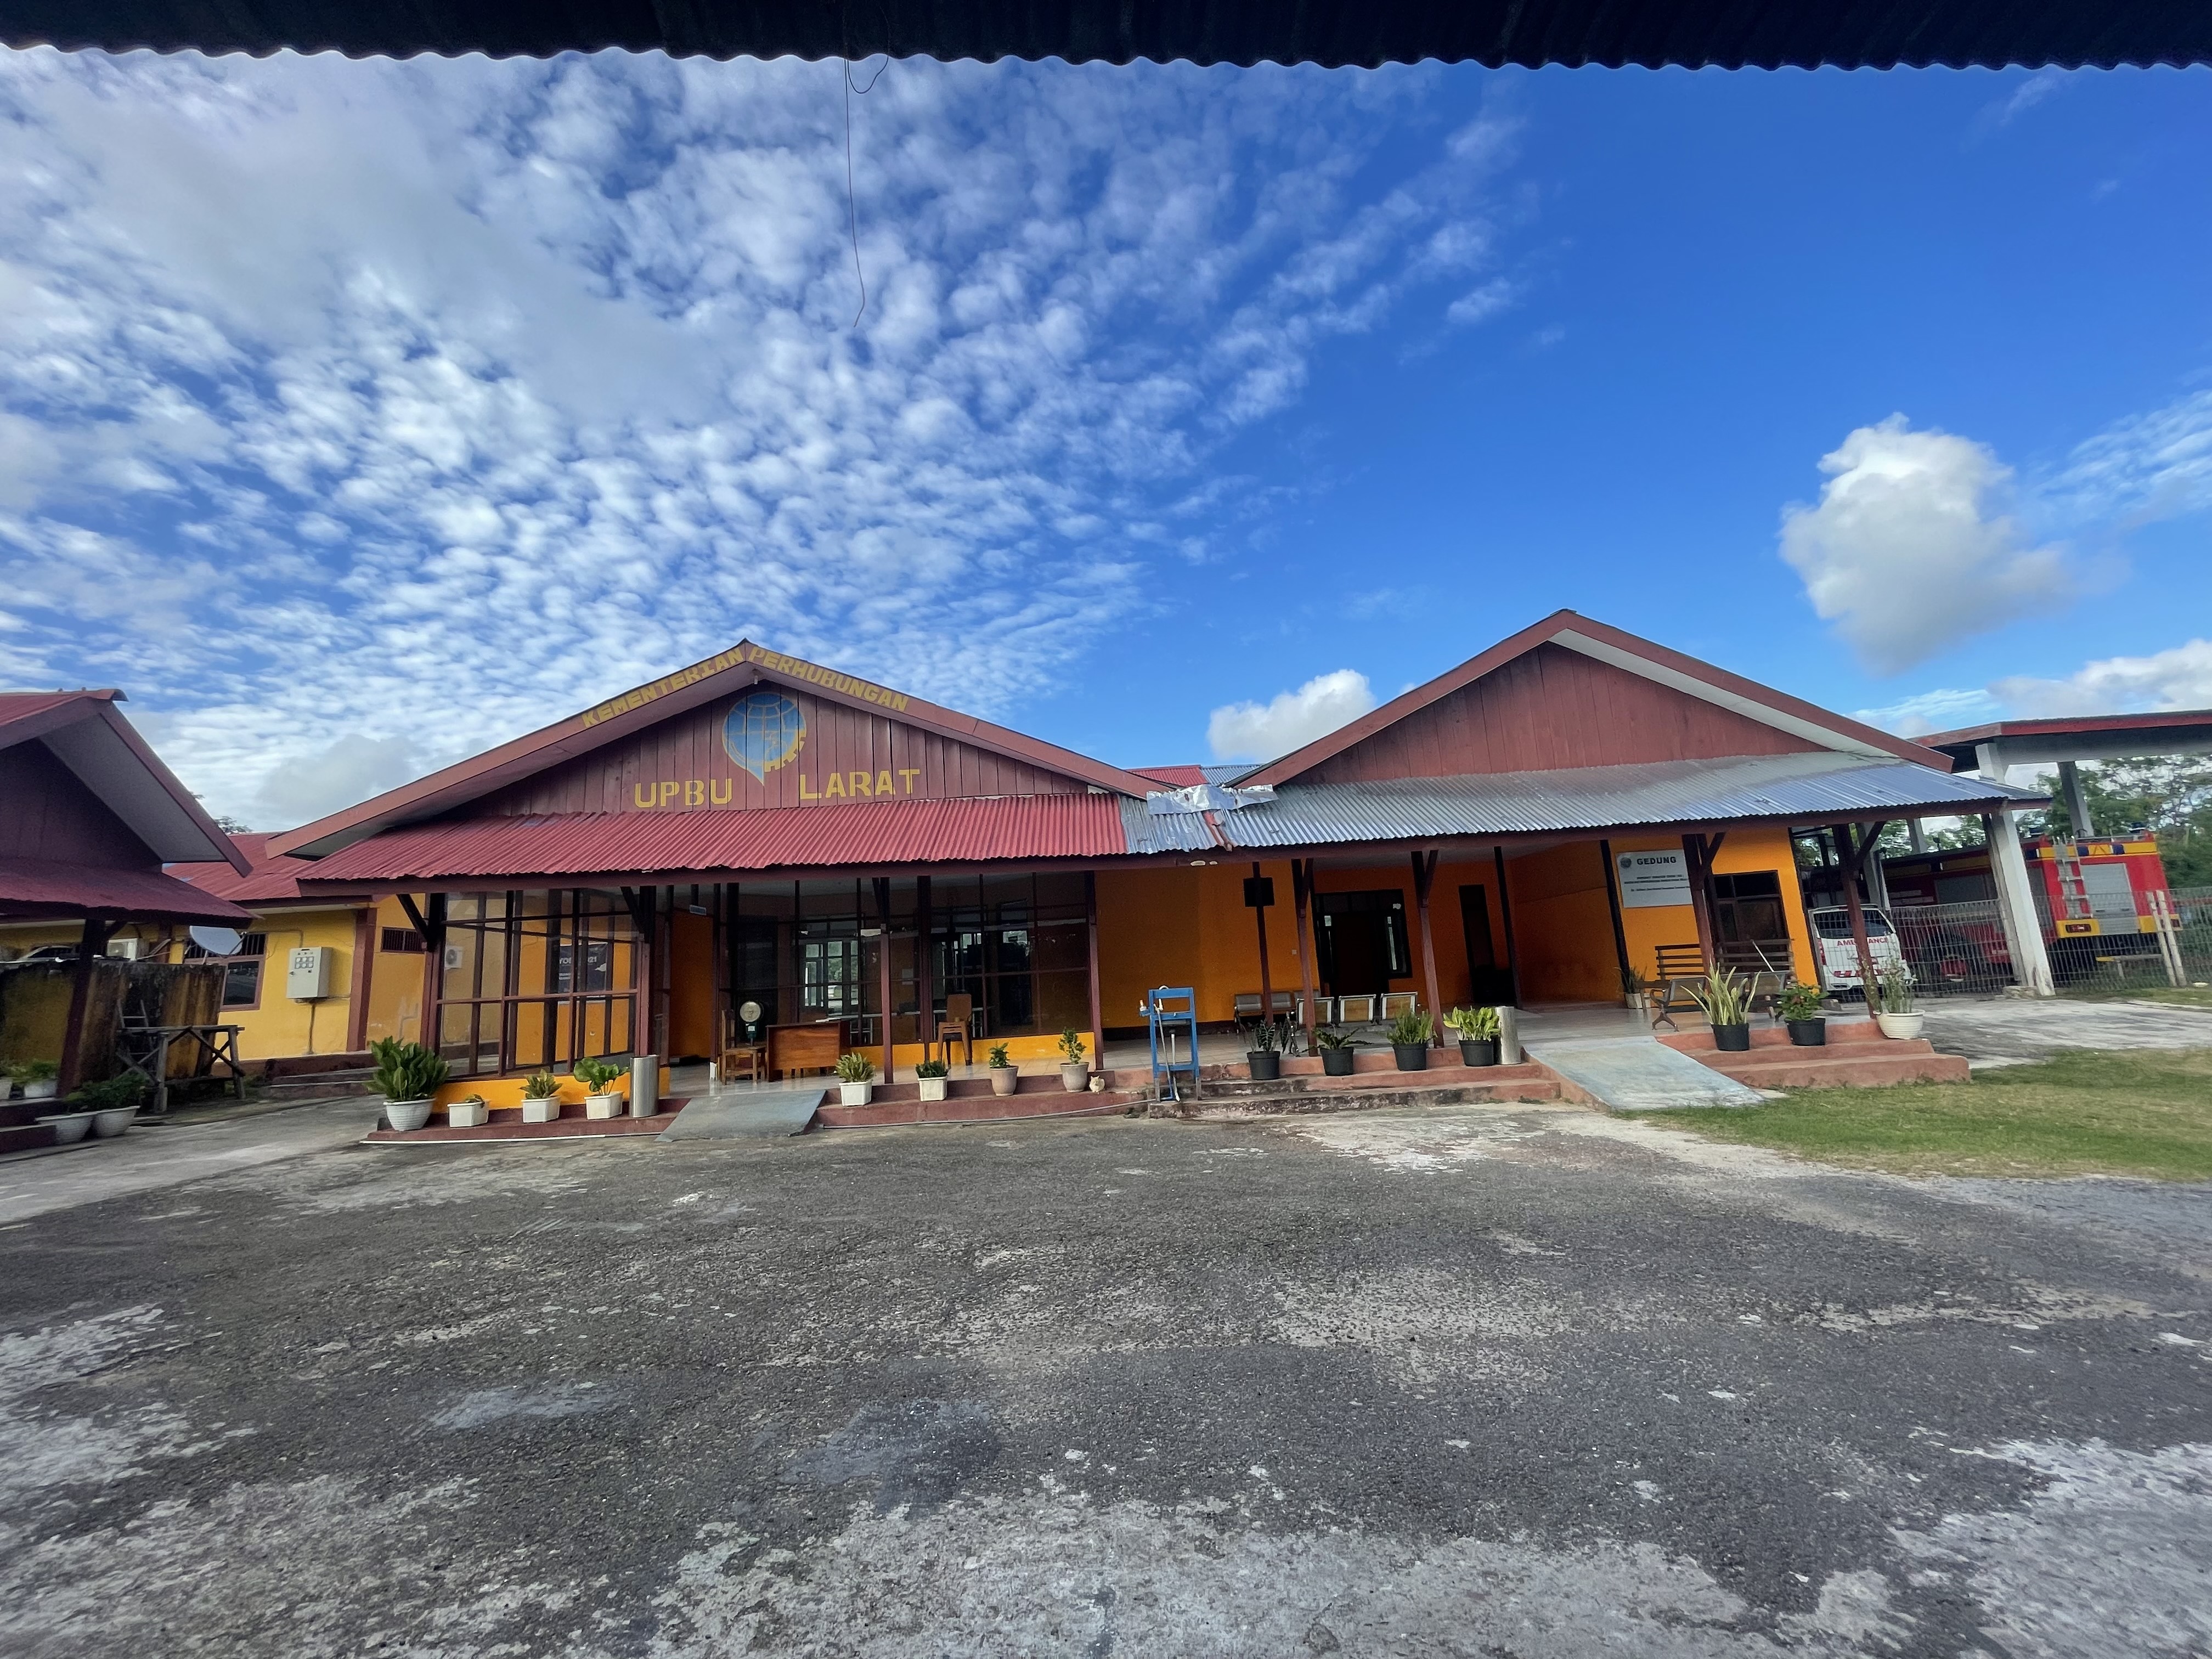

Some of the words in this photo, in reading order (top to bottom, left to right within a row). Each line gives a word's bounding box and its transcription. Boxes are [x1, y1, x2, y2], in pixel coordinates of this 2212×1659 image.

[582, 647, 743, 727] KEMENTERIAN
[748, 646, 909, 711] PERHUBUNGAN
[634, 778, 732, 808] UPBU
[799, 769, 920, 799] LARAT
[1637, 857, 1676, 865] GEDUNG
